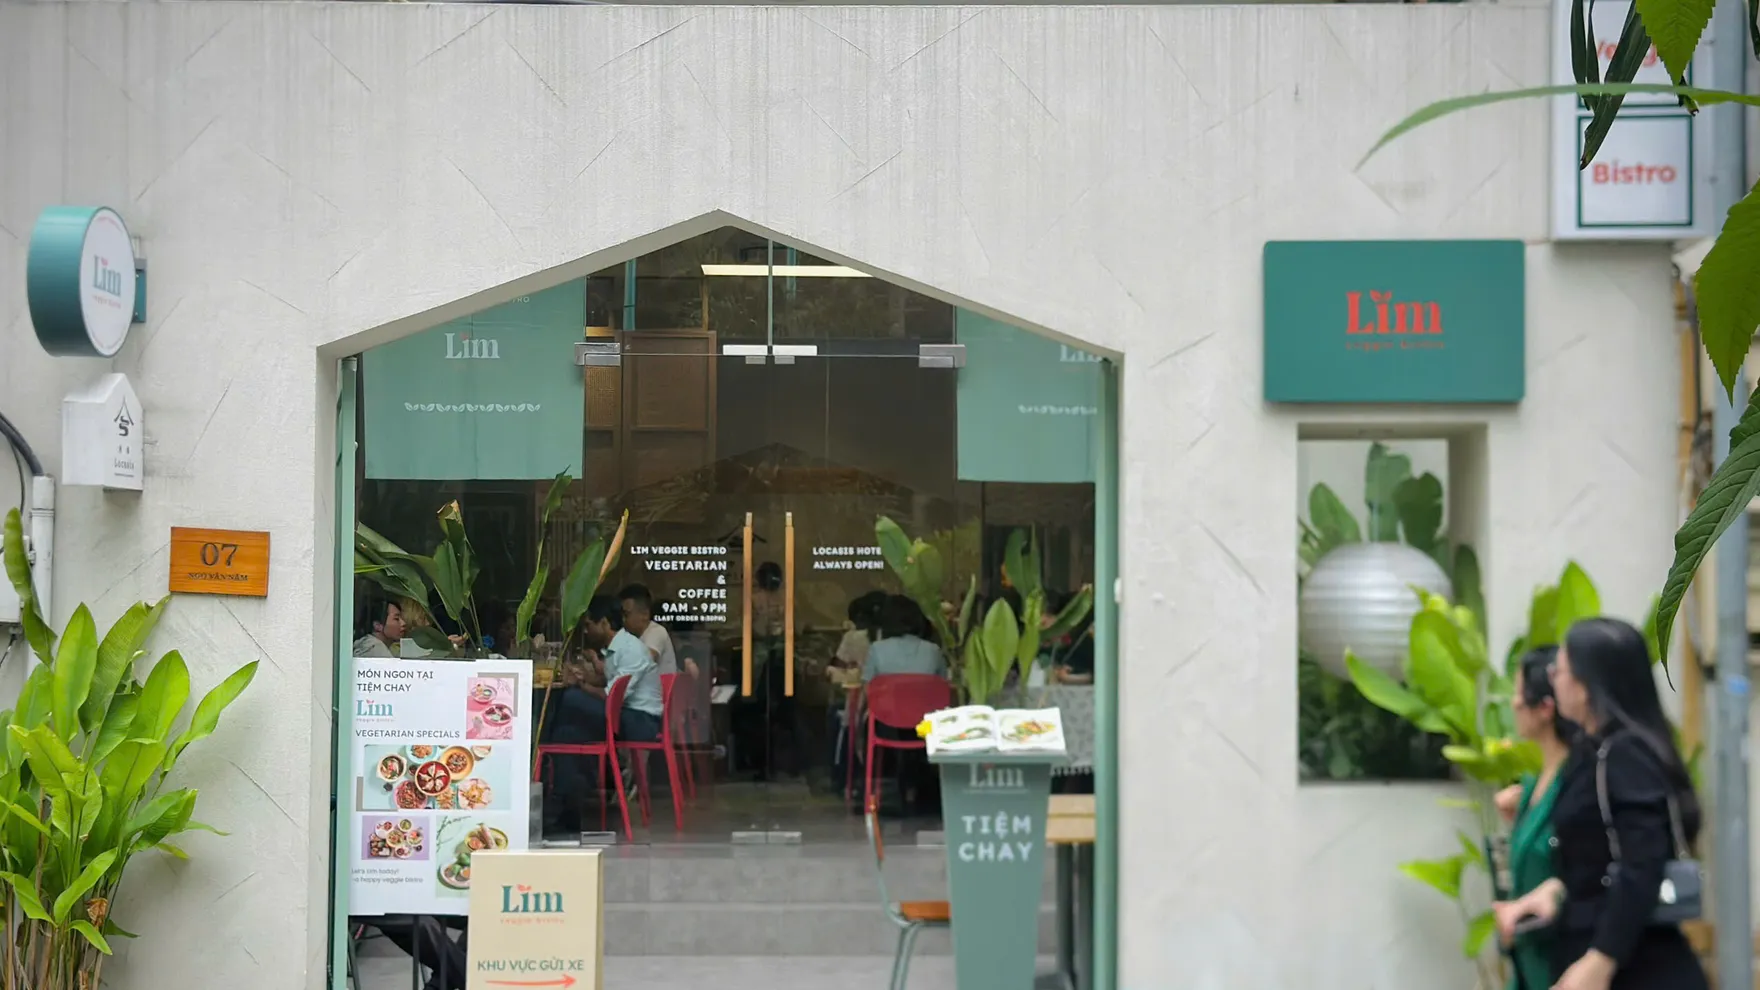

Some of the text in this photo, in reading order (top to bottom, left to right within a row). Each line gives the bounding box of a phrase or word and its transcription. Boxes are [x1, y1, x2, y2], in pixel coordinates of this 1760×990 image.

[1592, 160, 1676, 185] Bistro
[92, 254, 122, 298] Lim
[1346, 289, 1445, 335] Lim
[444, 332, 501, 359] Lim
[200, 542, 239, 567] 07
[630, 546, 727, 555] LIM VEGGIE BISTRO
[812, 546, 883, 556] LOCASIS HOTE
[645, 560, 727, 571] VEGETARIAN
[812, 560, 884, 570] ALWAYS OPEN!
[716, 574, 726, 585] &
[678, 588, 727, 599] COFFEE
[661, 602, 688, 613] 9AM
[700, 602, 727, 613] 9PM
[653, 614, 675, 623] (LAST
[675, 614, 699, 622] ORDER
[357, 669, 434, 681] MÓN NGON TẠI
[357, 682, 412, 694] TIỆM CHAY
[356, 699, 394, 717] Lim
[356, 729, 460, 739] VEGETARIAN SPECIALS
[969, 763, 1025, 788] Lim
[961, 811, 1032, 840] TIỆM
[958, 842, 1033, 862] CHAY
[500, 884, 565, 914] Lim
[477, 960, 506, 971] KHU
[508, 959, 537, 974] VỰC
[567, 960, 585, 971] XE
